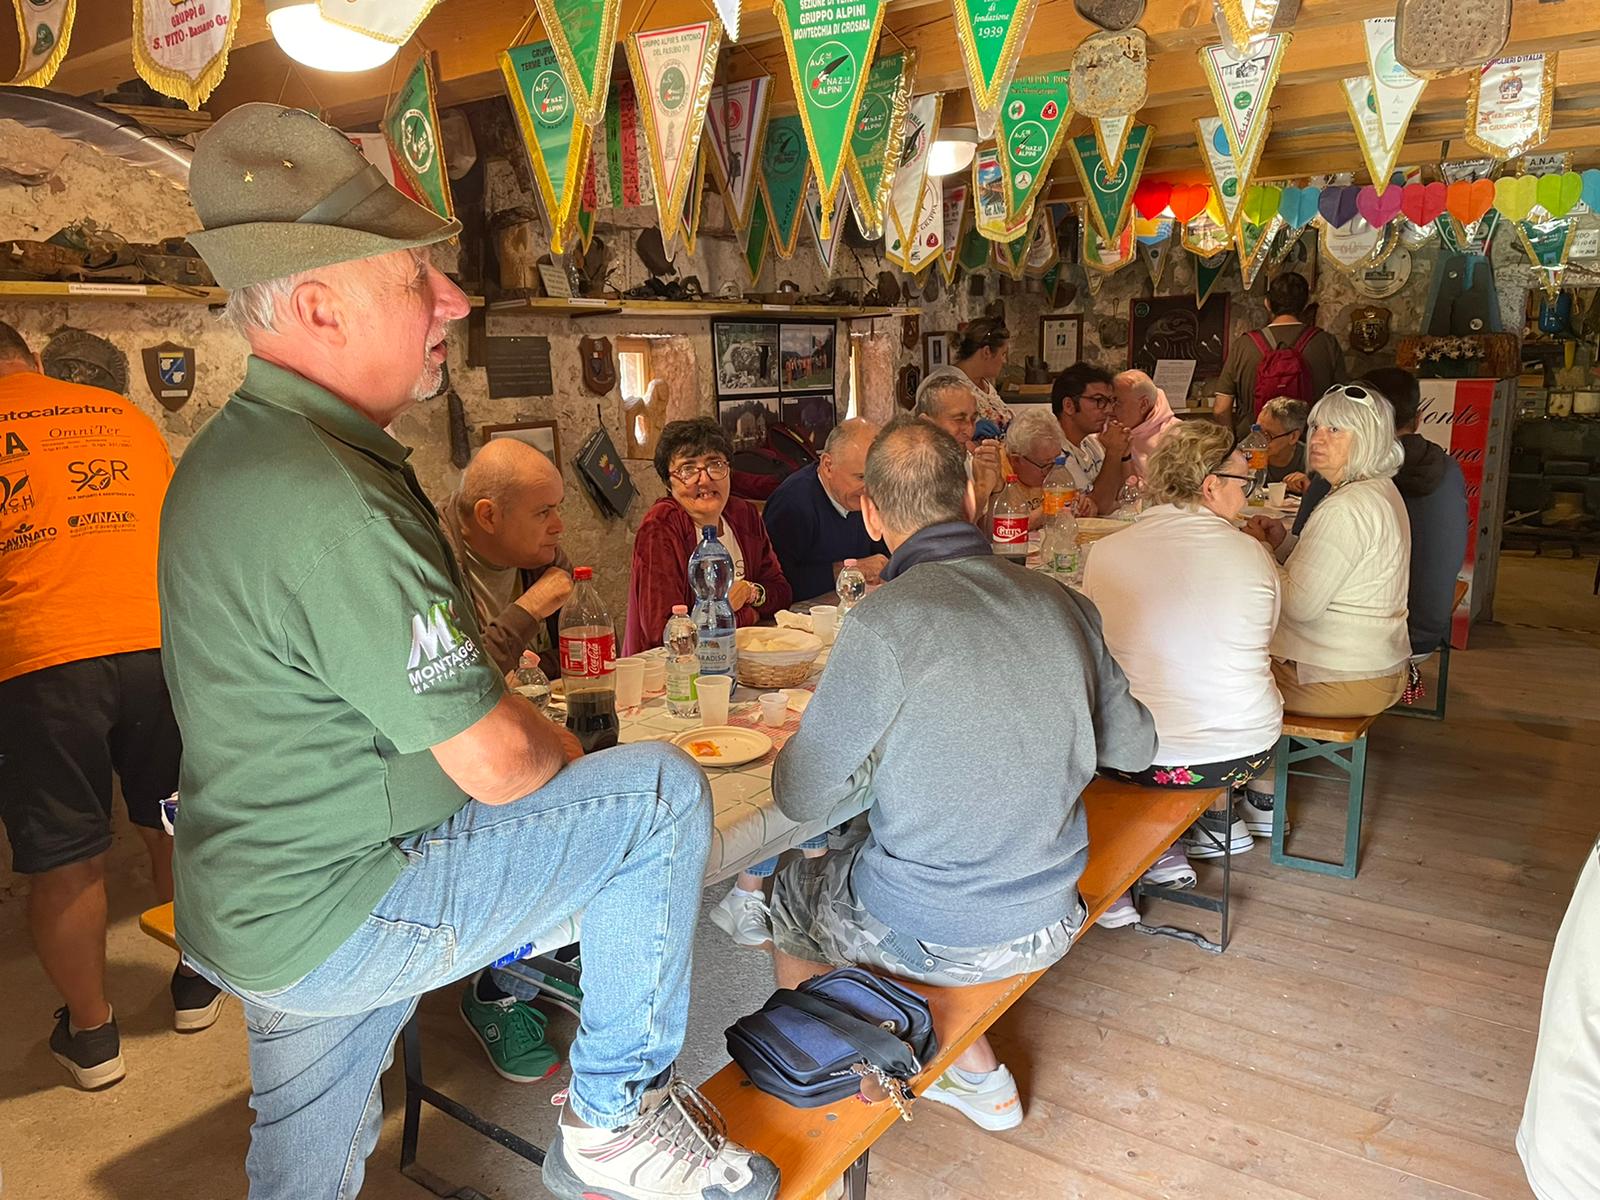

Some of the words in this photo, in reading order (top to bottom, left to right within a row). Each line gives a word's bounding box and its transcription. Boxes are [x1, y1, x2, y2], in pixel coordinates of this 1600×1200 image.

[171, 6, 198, 28] GRUPPI
[800, 9, 834, 25] GRUPPO
[835, 4, 866, 20] ALPINI
[972, 12, 1010, 26] fondazione
[164, 29, 185, 47] VITO
[793, 24, 832, 40] MONTECCHIA
[832, 22, 841, 35] DI
[841, 18, 871, 34] CROSARA
[978, 26, 1004, 38] 1939
[818, 86, 843, 96] ALPINI
[1416, 397, 1480, 426] onte
[408, 640, 475, 686] MONTAGG
[413, 669, 456, 695] MATTIA
